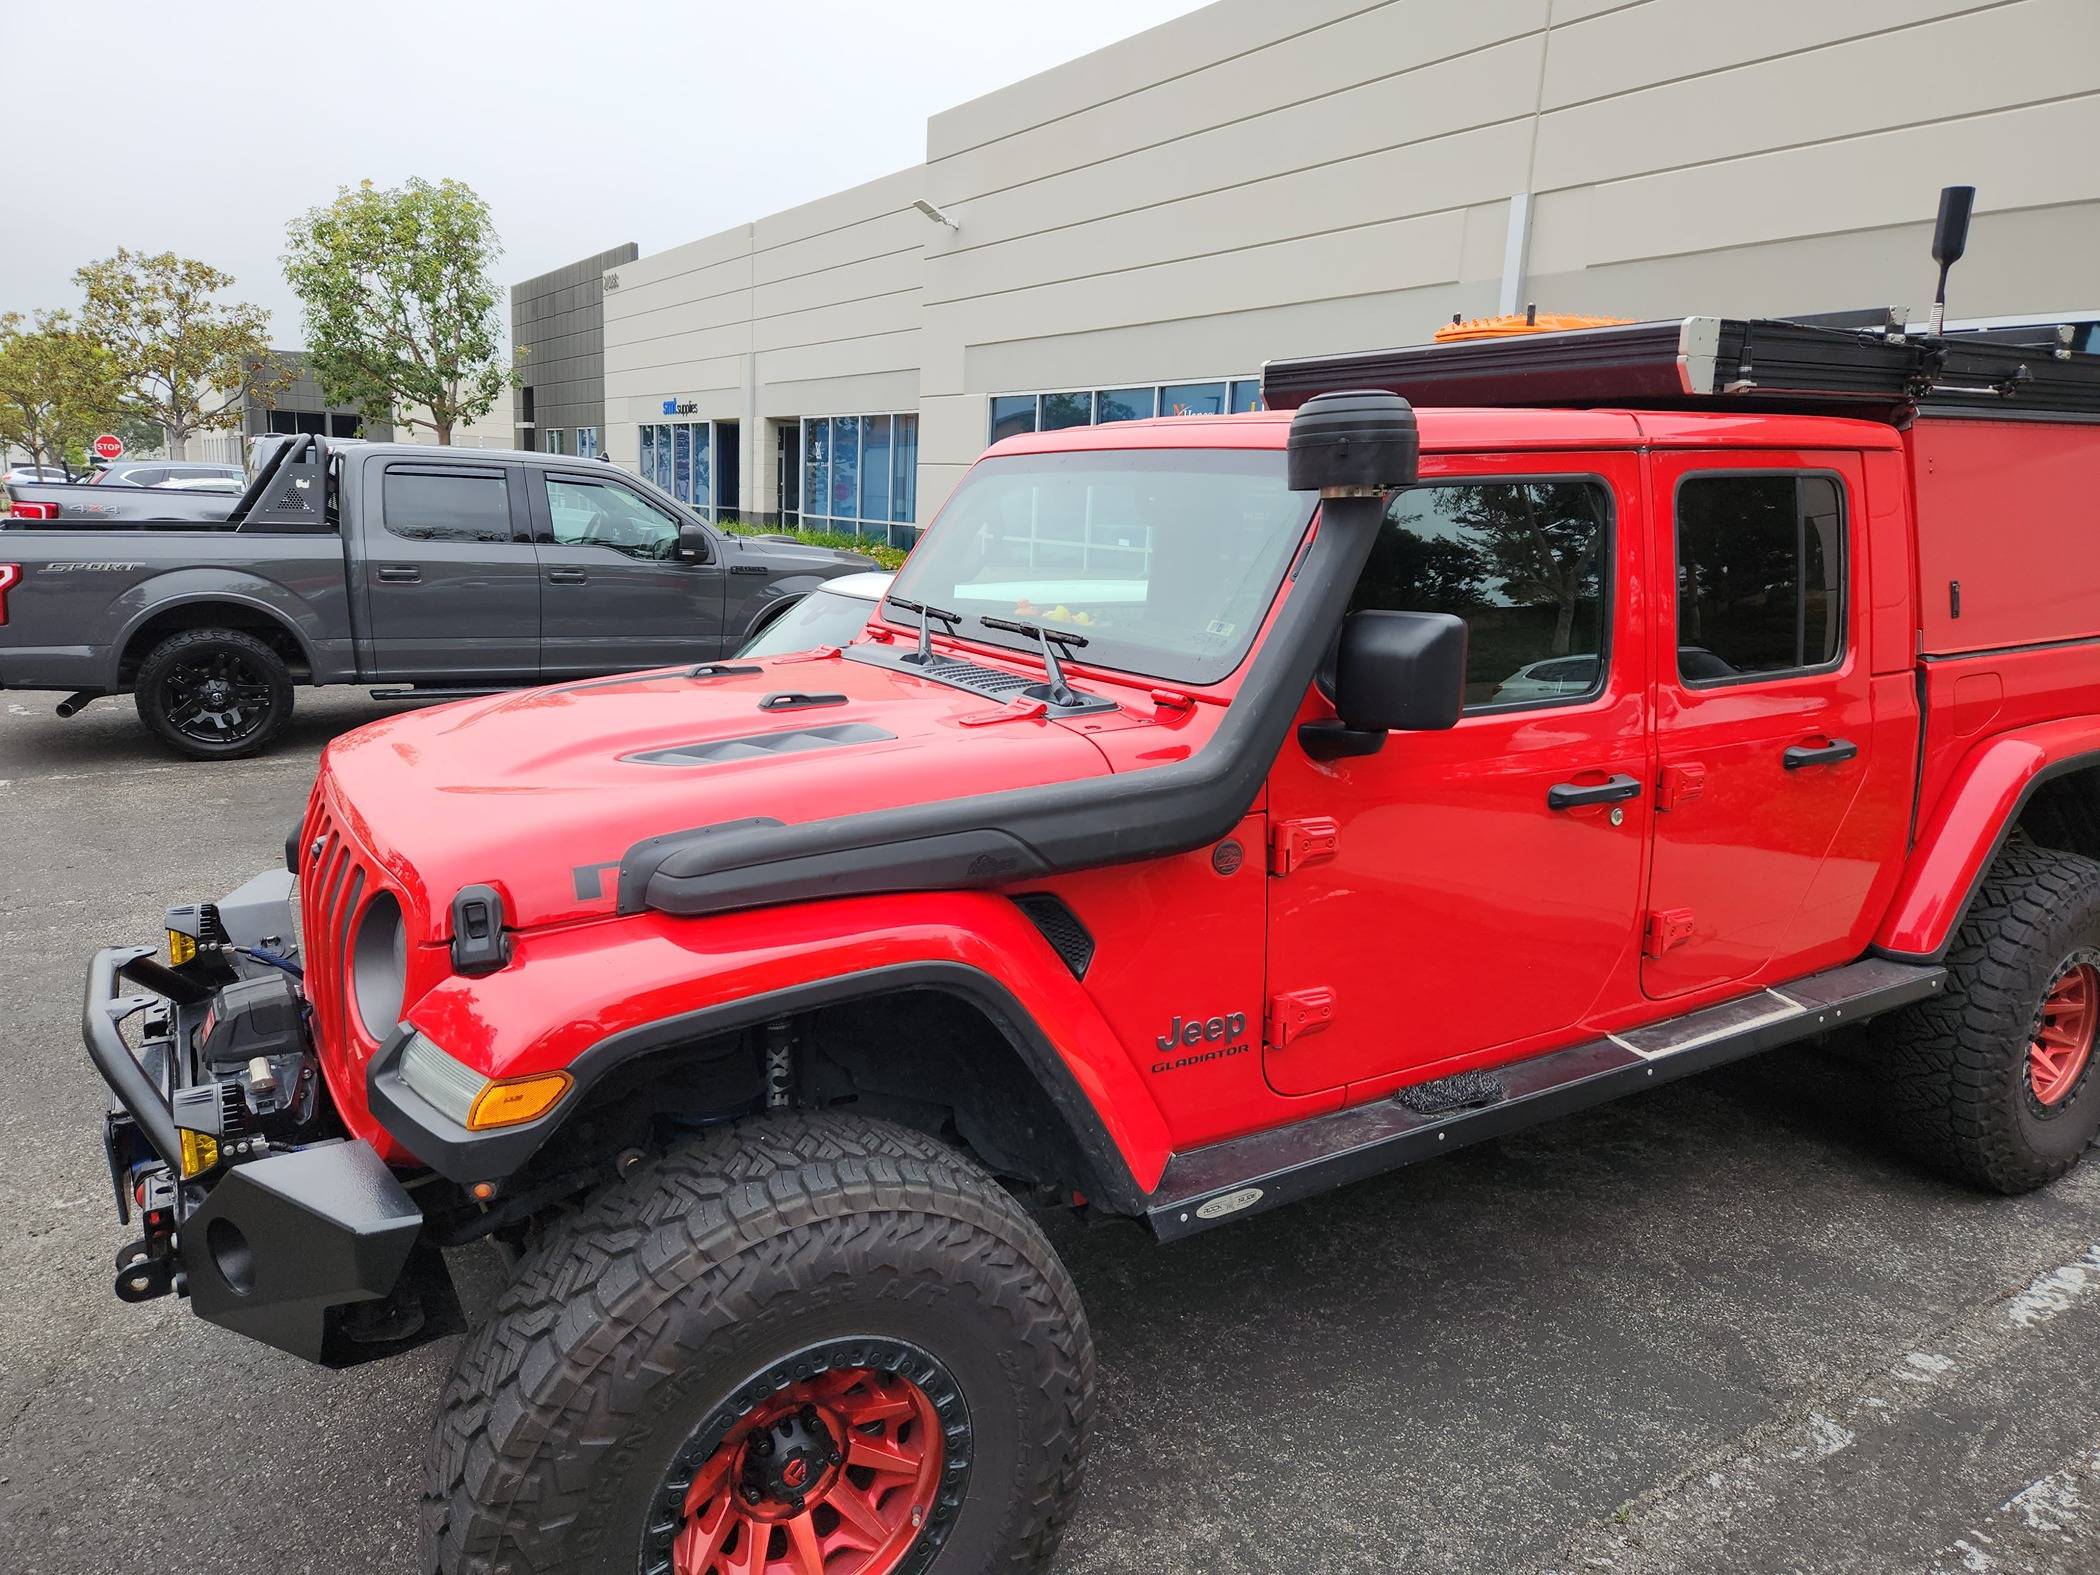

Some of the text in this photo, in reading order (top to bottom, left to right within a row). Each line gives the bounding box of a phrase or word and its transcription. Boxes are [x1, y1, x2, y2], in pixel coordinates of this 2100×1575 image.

[676, 400, 698, 418] supplies
[97, 442, 120, 451] STOP
[37, 562, 146, 575] SPORT
[1157, 1011, 1246, 1052] Jeep
[1151, 1044, 1249, 1073] GLADIATOR
